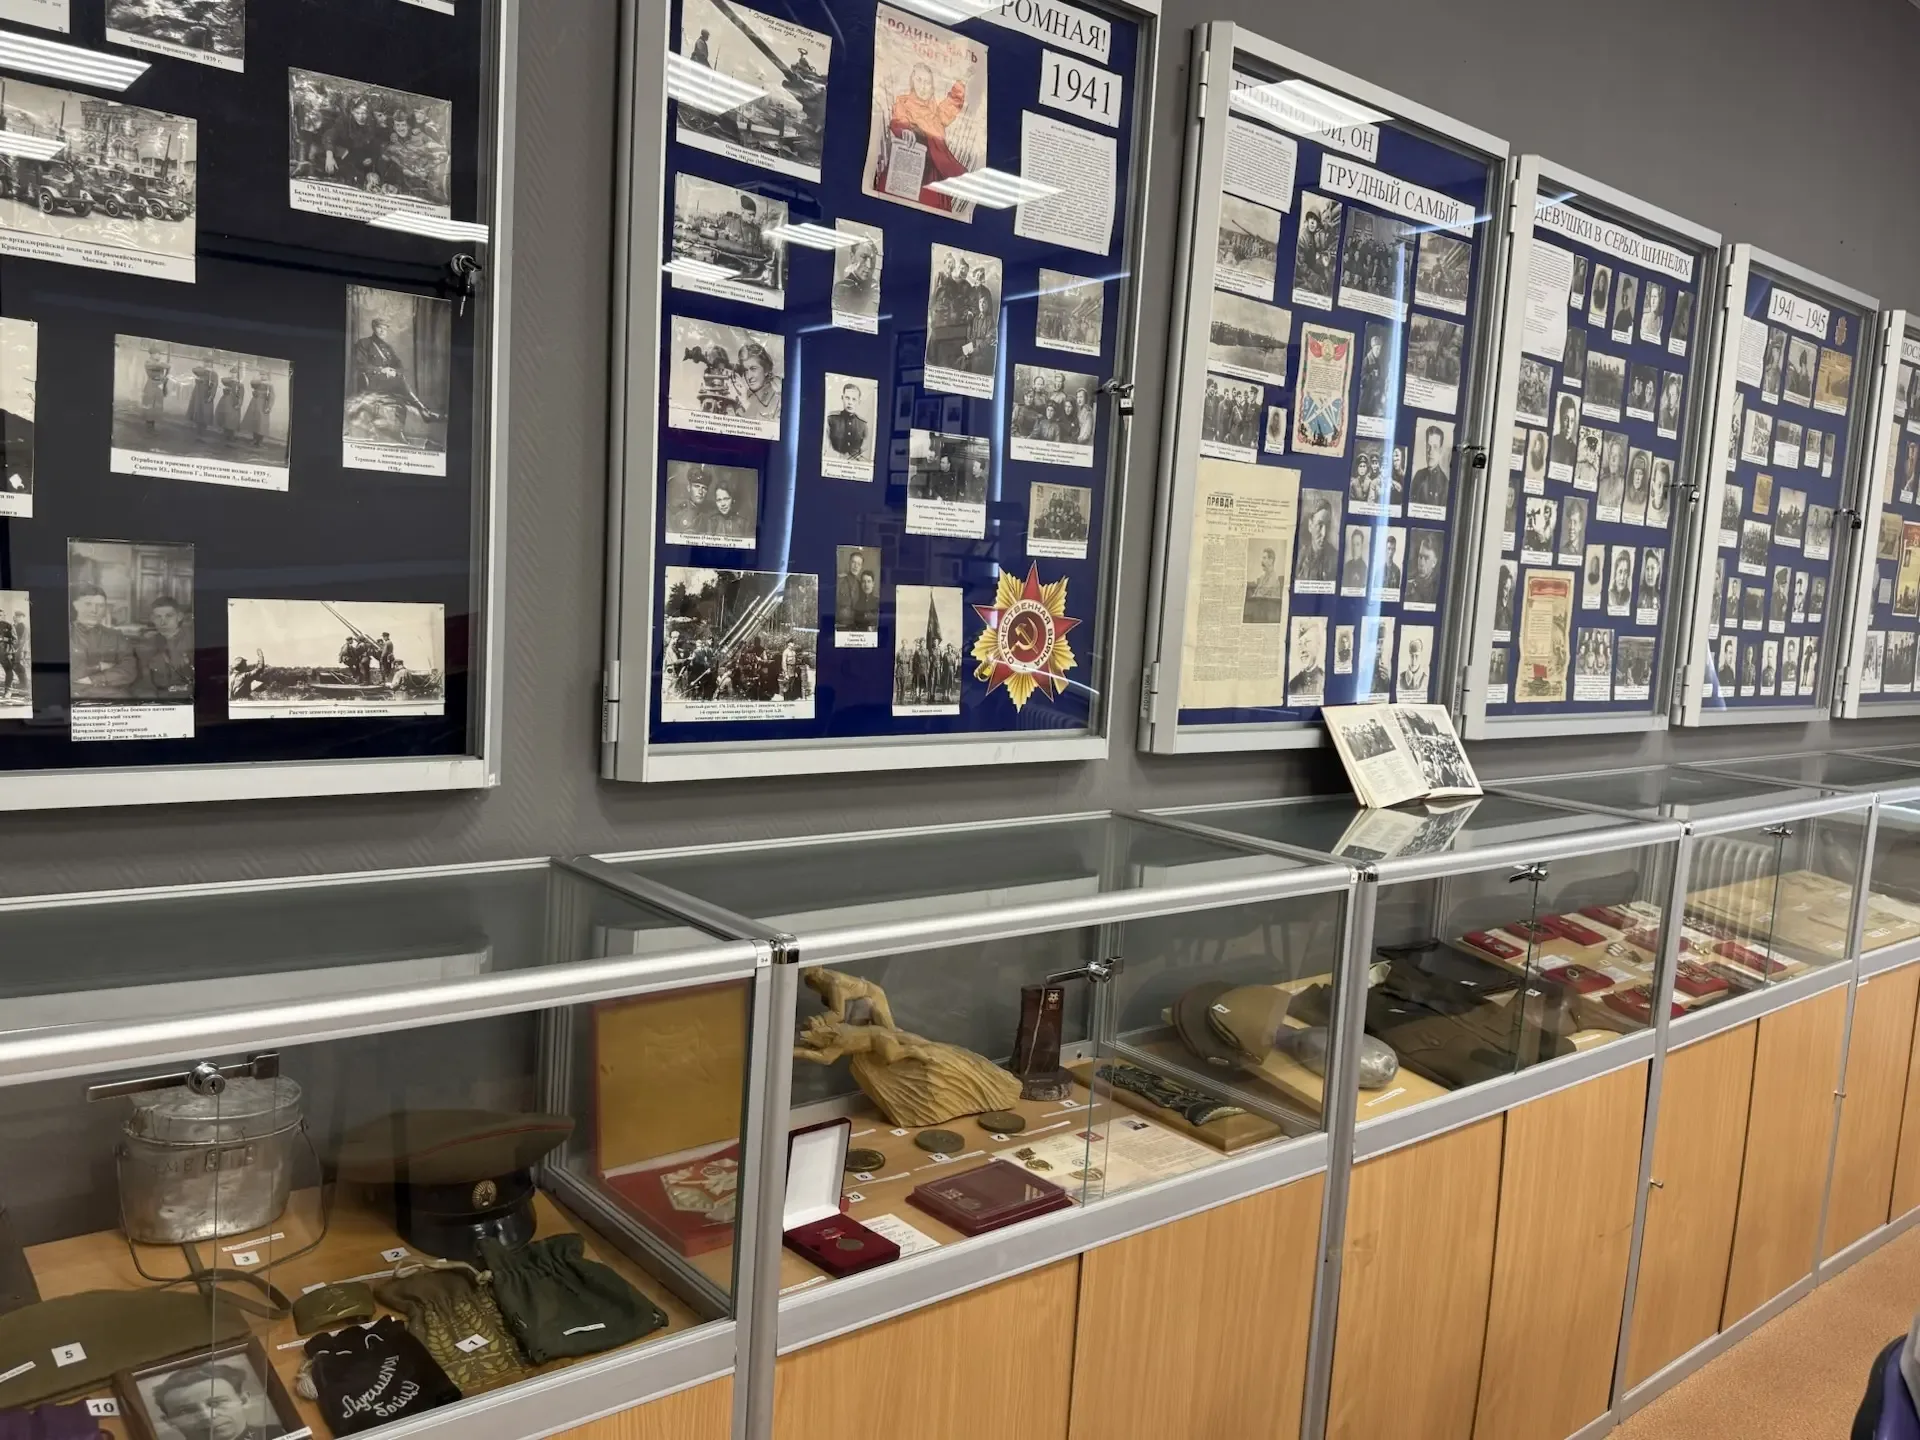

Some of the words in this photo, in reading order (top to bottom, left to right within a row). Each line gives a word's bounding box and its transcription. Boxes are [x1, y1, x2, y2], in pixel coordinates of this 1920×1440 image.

[1051, 63, 1110, 116] 1941
[1351, 127, 1374, 153] ОН
[1326, 163, 1400, 207] ТРУДНЫЙ
[1534, 201, 1594, 240] ДЕВУШКИ
[1594, 225, 1603, 243] В
[1604, 229, 1641, 258] СЕРЫХ
[1641, 244, 1691, 277] ШИНЕЛЯХ
[112, 260, 128, 269] 1941
[1772, 295, 1795, 321] 1941
[1805, 308, 1826, 333] 1945
[1902, 342, 1920, 359] ПОС
[130, 455, 164, 466] Отработка
[1205, 496, 1234, 509] ПРАВДА
[1001, 602, 1052, 665] ОТЕЧЕСТВЕННАЯ
[1034, 628, 1053, 667] ВОЙНА
[241, 1255, 250, 1263] 3
[64, 1349, 74, 1359] 5
[342, 1355, 400, 1419] Лучшему
[373, 1380, 420, 1417] бойцу
[92, 1402, 115, 1413] 10
